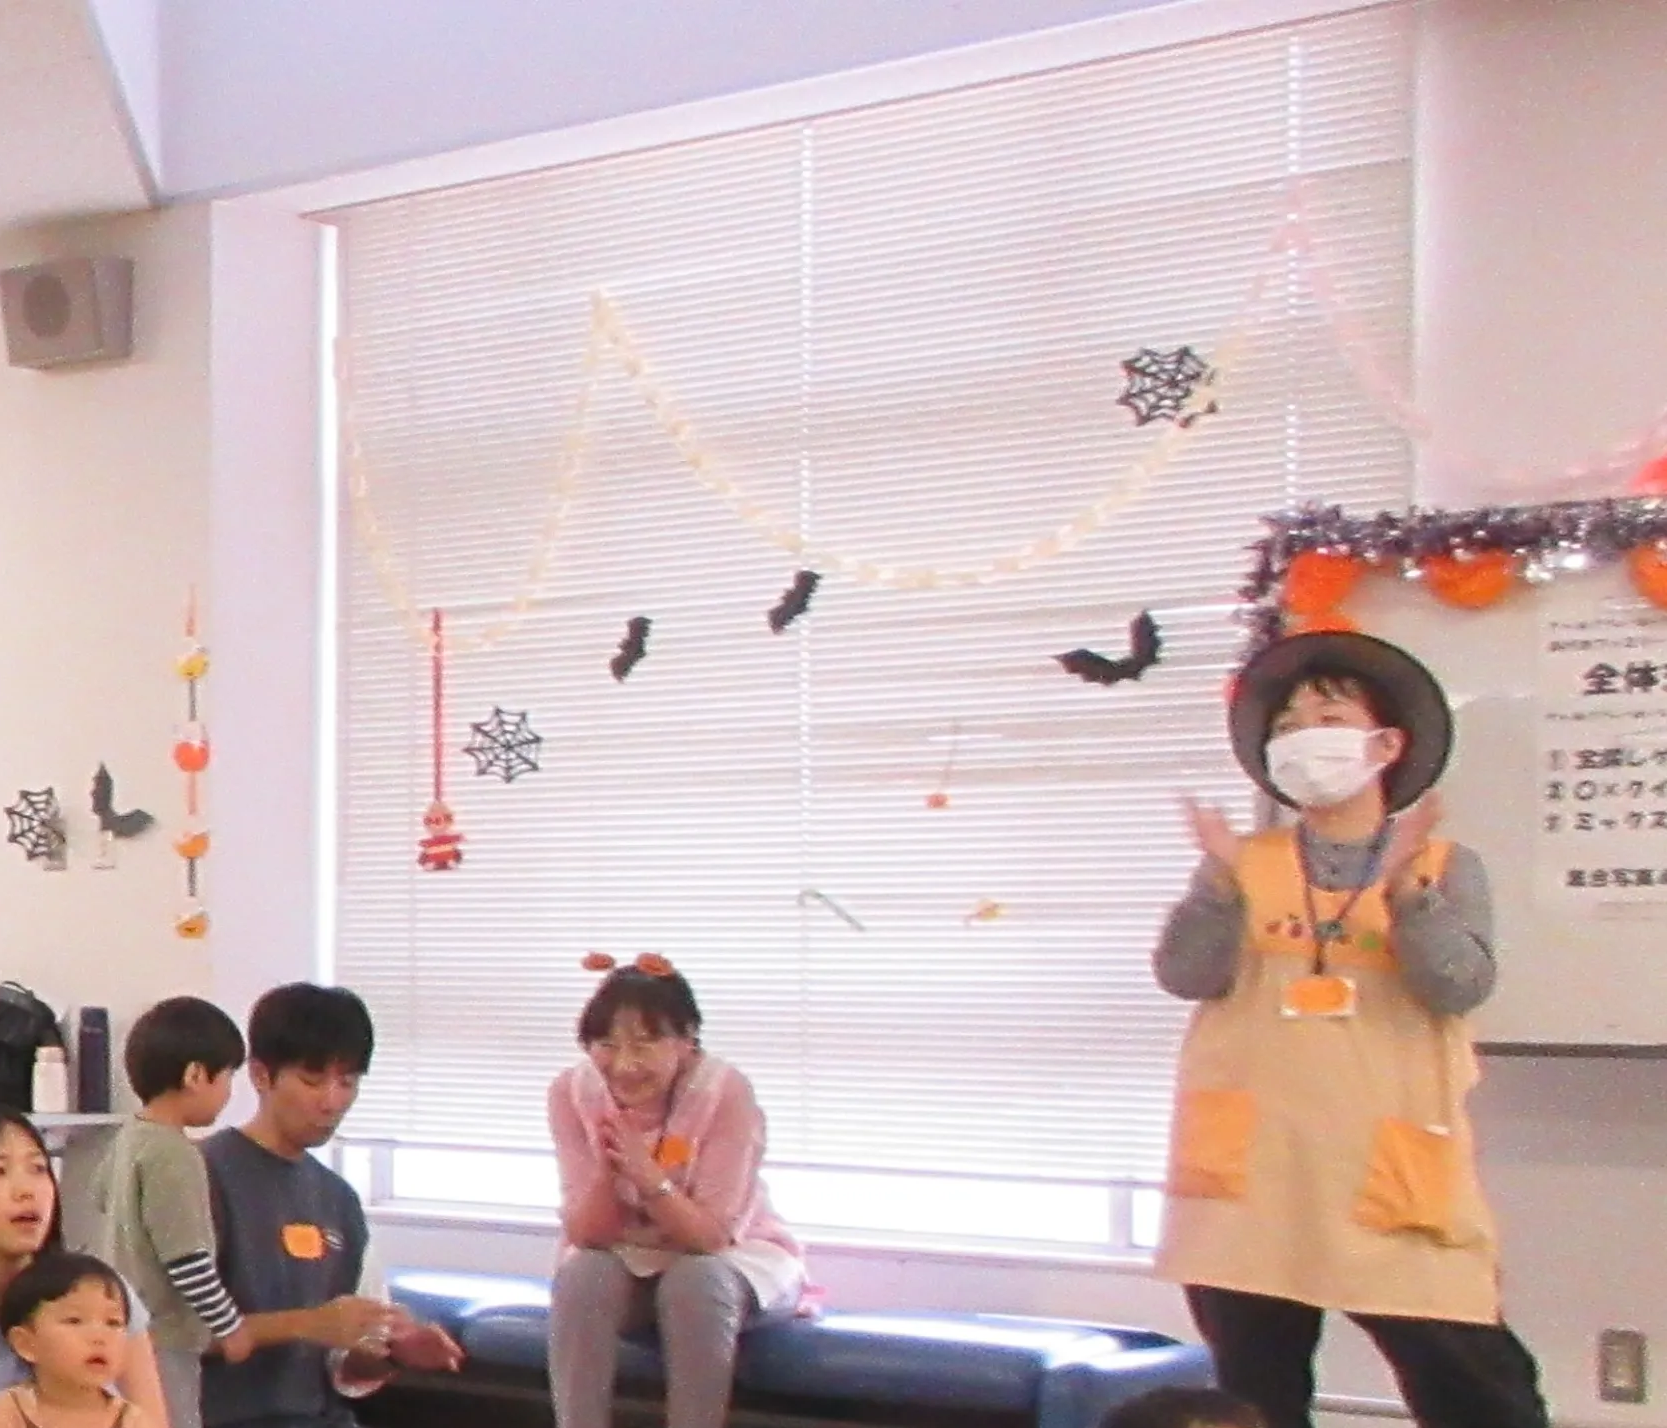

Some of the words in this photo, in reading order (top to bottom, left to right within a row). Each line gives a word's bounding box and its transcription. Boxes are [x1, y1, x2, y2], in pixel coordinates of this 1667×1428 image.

[1583, 661, 1667, 696] 全体
[1567, 867, 1667, 888] 集合写真
